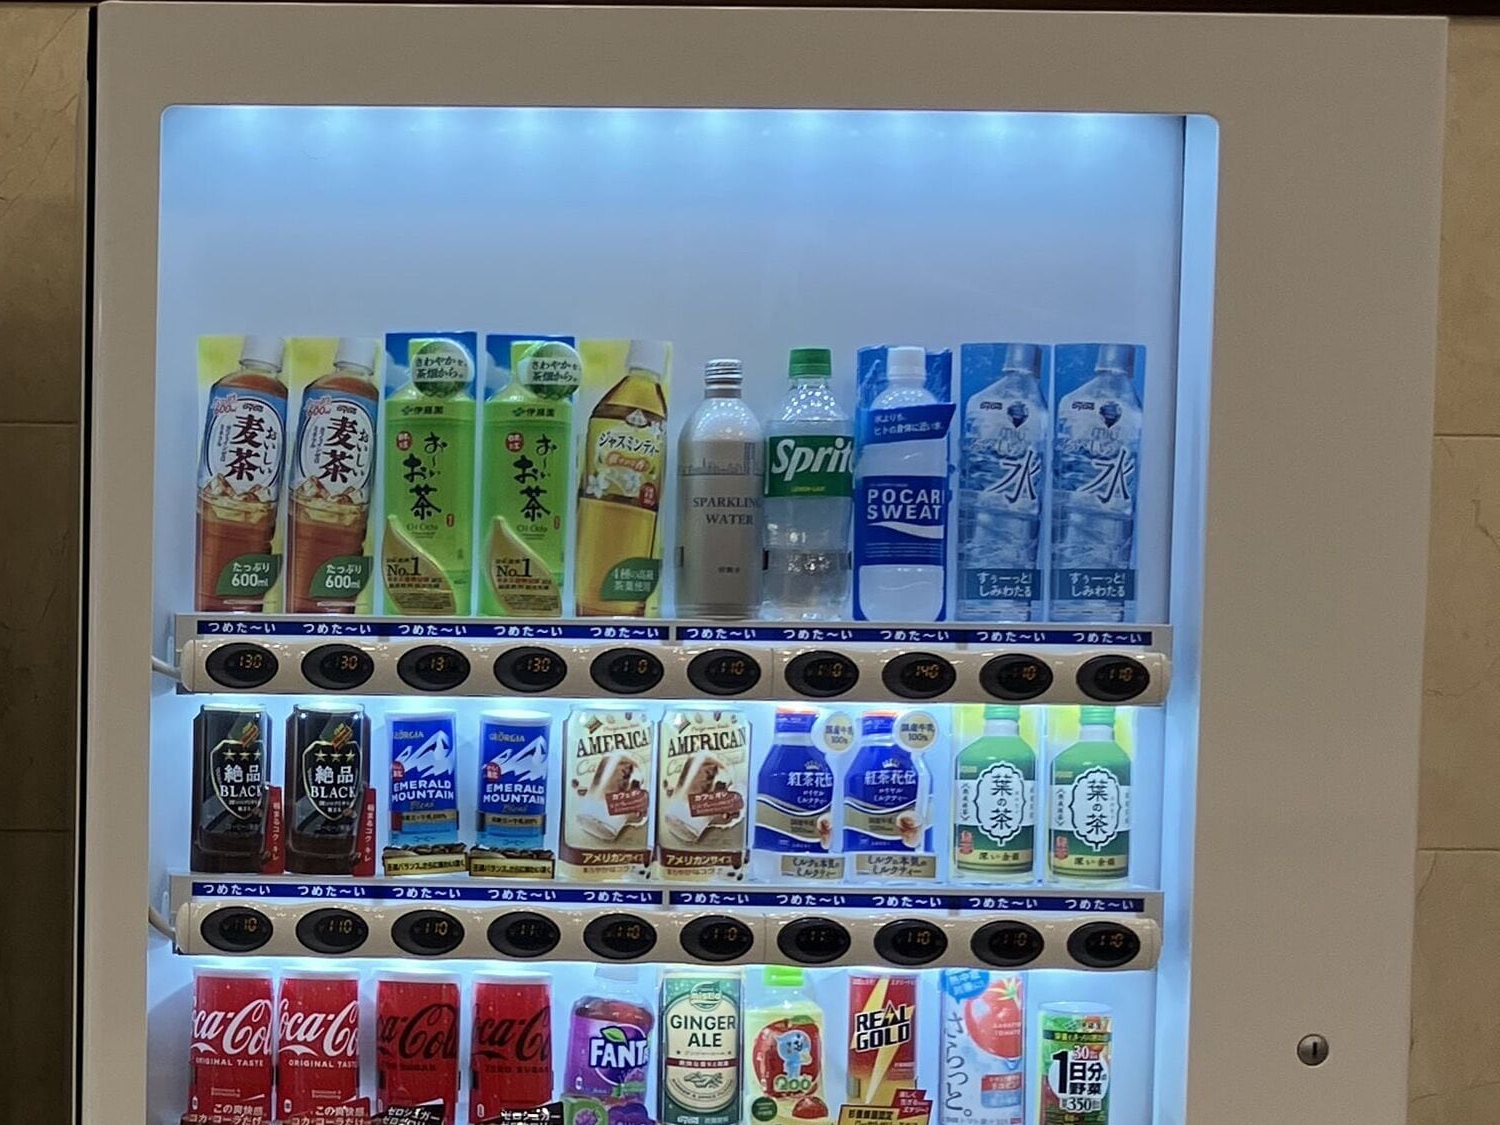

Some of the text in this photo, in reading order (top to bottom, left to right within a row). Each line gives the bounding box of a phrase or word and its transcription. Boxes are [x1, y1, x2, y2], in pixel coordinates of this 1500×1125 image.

[225, 414, 265, 482] 麦茶
[319, 416, 358, 484] 麦茶
[599, 431, 660, 455] ジャスミンティー
[771, 437, 854, 481] Sprit
[987, 450, 1040, 503] 水
[1081, 449, 1134, 503] 水
[402, 453, 442, 520] お茶
[513, 455, 550, 522] お茶
[705, 514, 754, 525] WATER
[867, 504, 942, 520] SWEAT
[232, 562, 269, 573] たっぷり
[326, 563, 362, 575] たっぷり
[231, 574, 269, 587] 600ml
[325, 575, 361, 589] 600ml
[979, 585, 1032, 597] しみわたる
[1072, 585, 1126, 597] しみわたる
[668, 727, 746, 758] AMERICAN
[224, 764, 260, 783] 絶品
[315, 765, 354, 785] 絶品
[864, 770, 916, 785] 紅茶花伝
[310, 786, 356, 798] BLACK
[393, 779, 451, 792] EMERALD
[486, 783, 545, 794] EMERALD
[392, 789, 454, 802] MOUNTAIN
[483, 794, 545, 805] MOUNTAIN
[990, 775, 1014, 830] 葉の茶
[1085, 780, 1109, 836] 葉の茶
[670, 1014, 736, 1030] GINGER
[856, 1002, 910, 1032] REAL
[687, 1033, 722, 1048] ALE
[856, 1023, 910, 1051] GOLD
[237, 1059, 264, 1067] TASTE
[288, 1059, 334, 1068] ORIGINAL
[1069, 1082, 1102, 1095] 野菜
